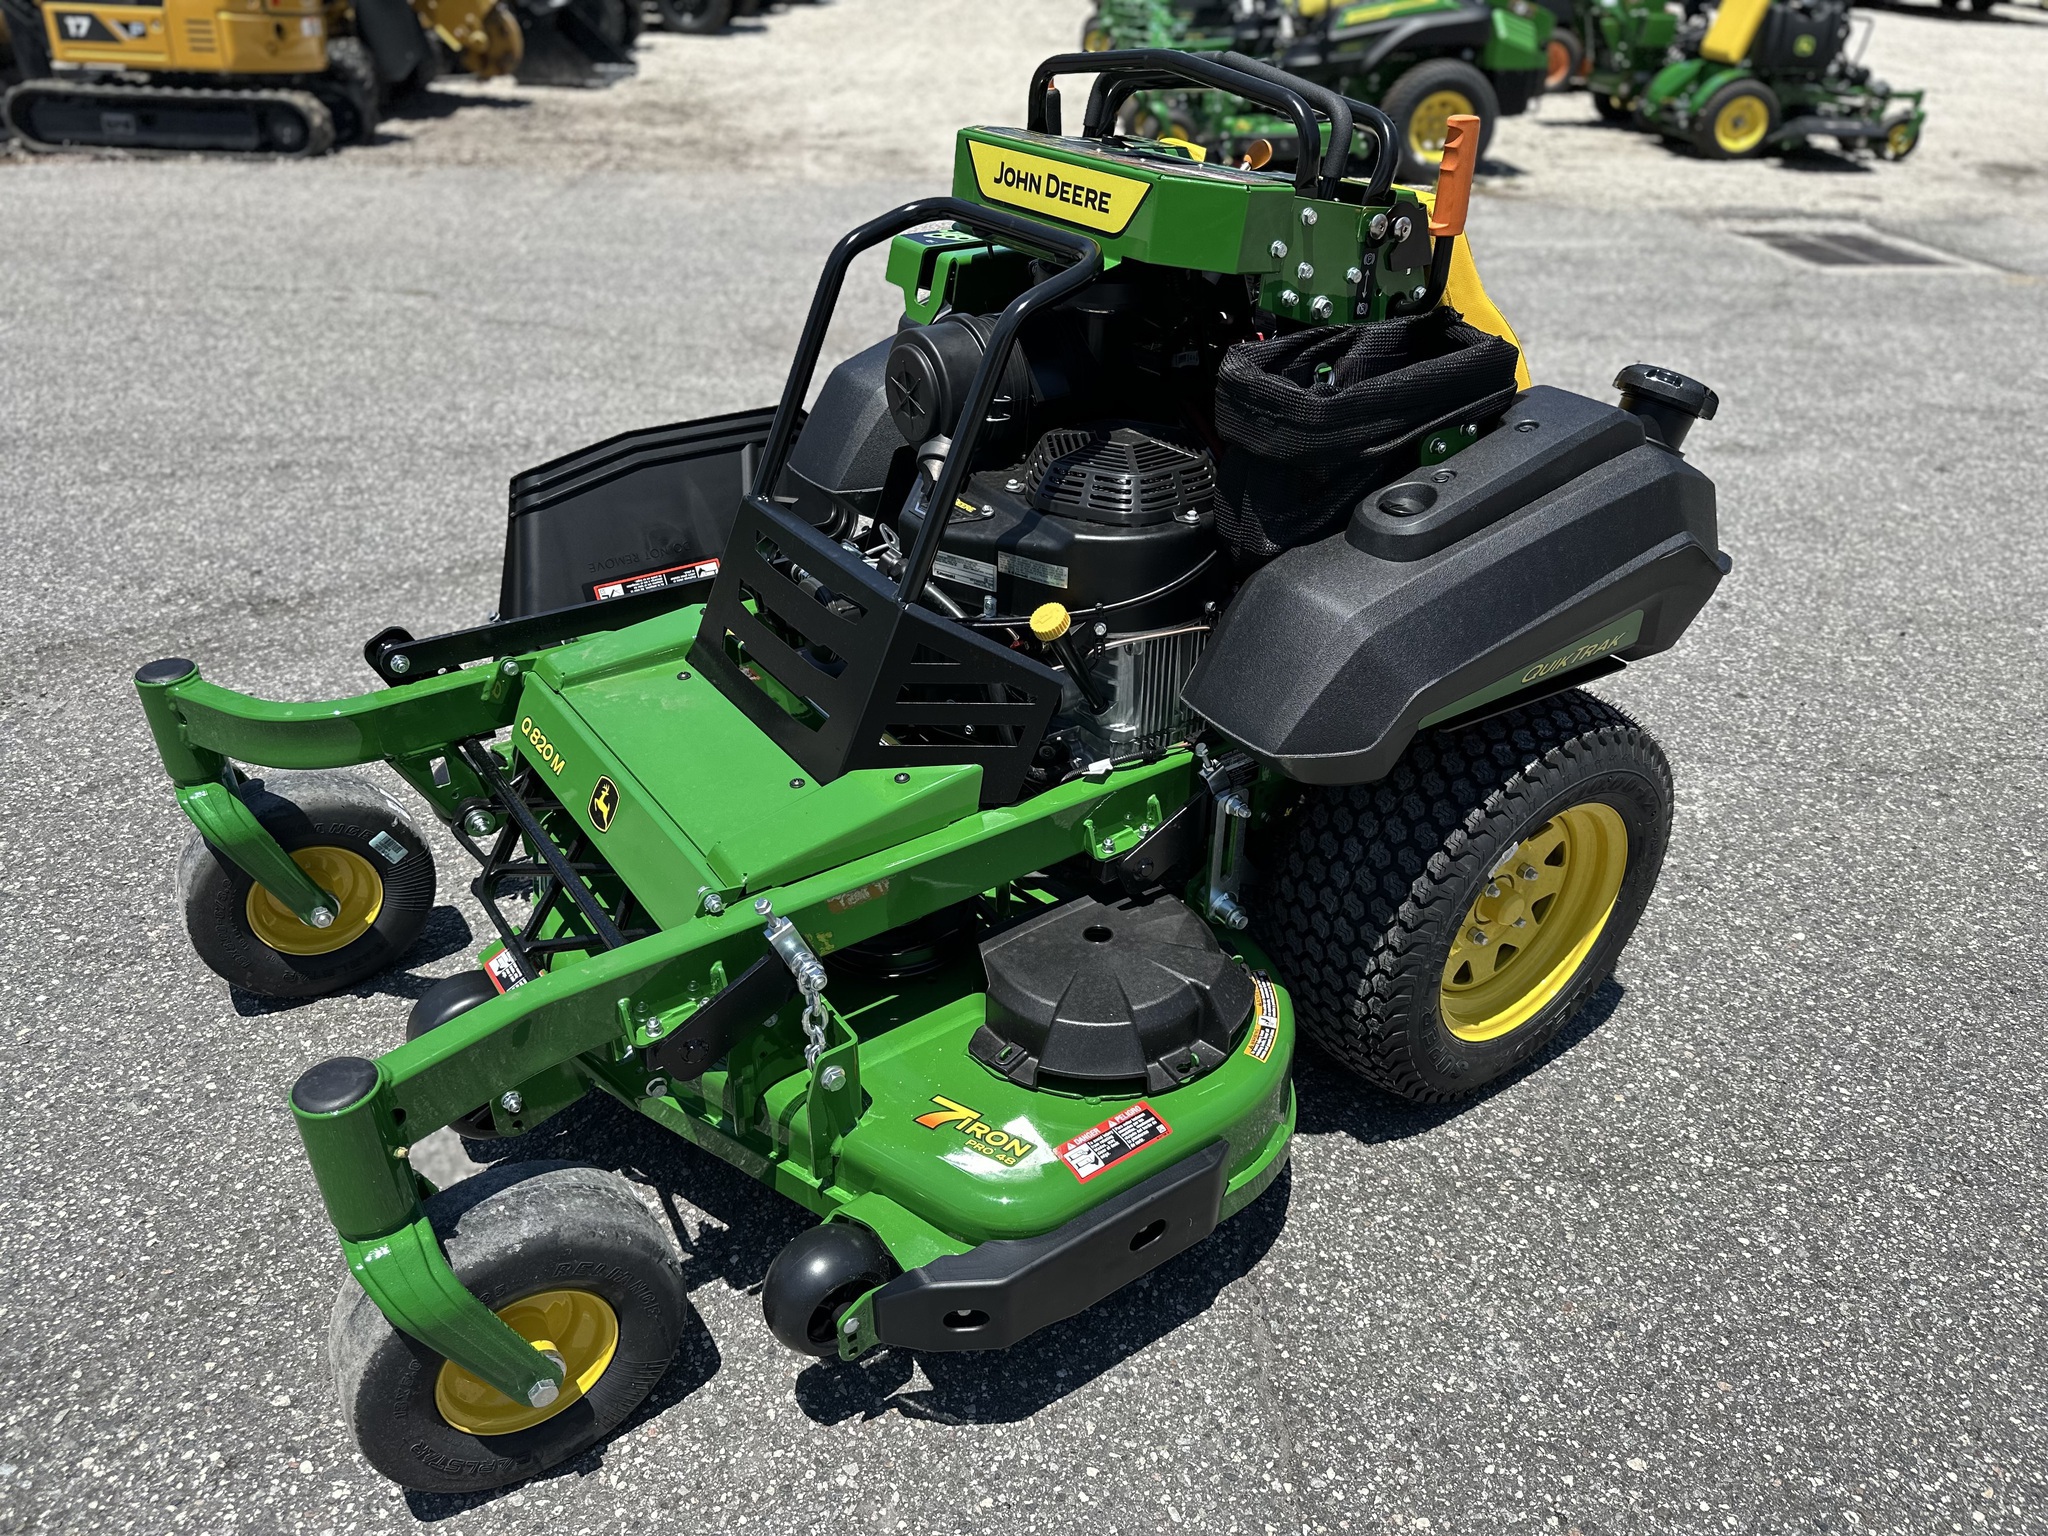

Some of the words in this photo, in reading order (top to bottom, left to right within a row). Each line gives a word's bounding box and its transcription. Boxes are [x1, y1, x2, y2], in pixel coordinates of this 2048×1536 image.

[64, 15, 91, 38] 17
[993, 161, 1042, 195] JOHN
[1045, 173, 1112, 214] DEERE
[587, 552, 641, 574] REMOVE
[1421, 1004, 1470, 1079] SUPER
[1114, 1105, 1142, 1124] PELIGRO
[1073, 1127, 1102, 1145] DANGER
[965, 1138, 995, 1156] PRO
[995, 1152, 1018, 1167] 48
[552, 1261, 661, 1318] RELIANCE
